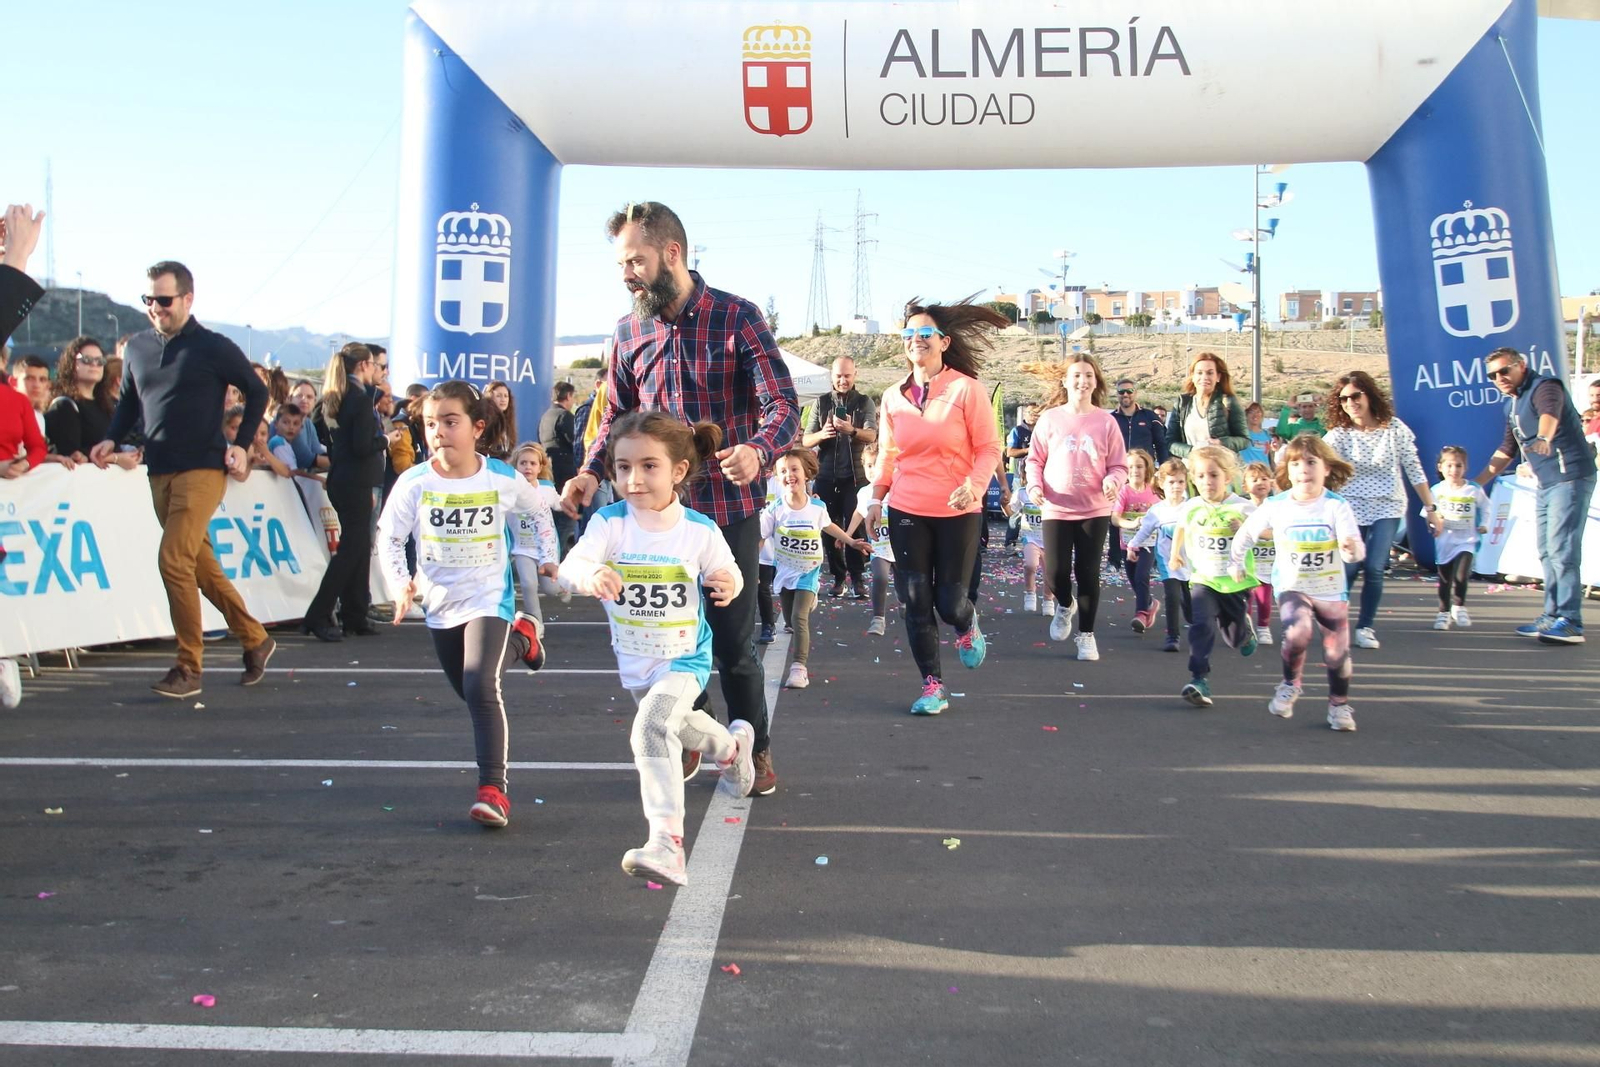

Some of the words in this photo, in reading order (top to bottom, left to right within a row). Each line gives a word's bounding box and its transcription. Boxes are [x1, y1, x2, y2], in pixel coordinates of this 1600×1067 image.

[879, 16, 1192, 79] ALMERÍA
[879, 92, 1035, 126] CIUDAD
[1414, 345, 1556, 391] ALMÍA
[429, 506, 494, 527] 8473
[780, 536, 819, 551] 8255
[1198, 536, 1234, 550] 829
[621, 552, 648, 561] SUPER
[629, 609, 666, 618] CARMEN
